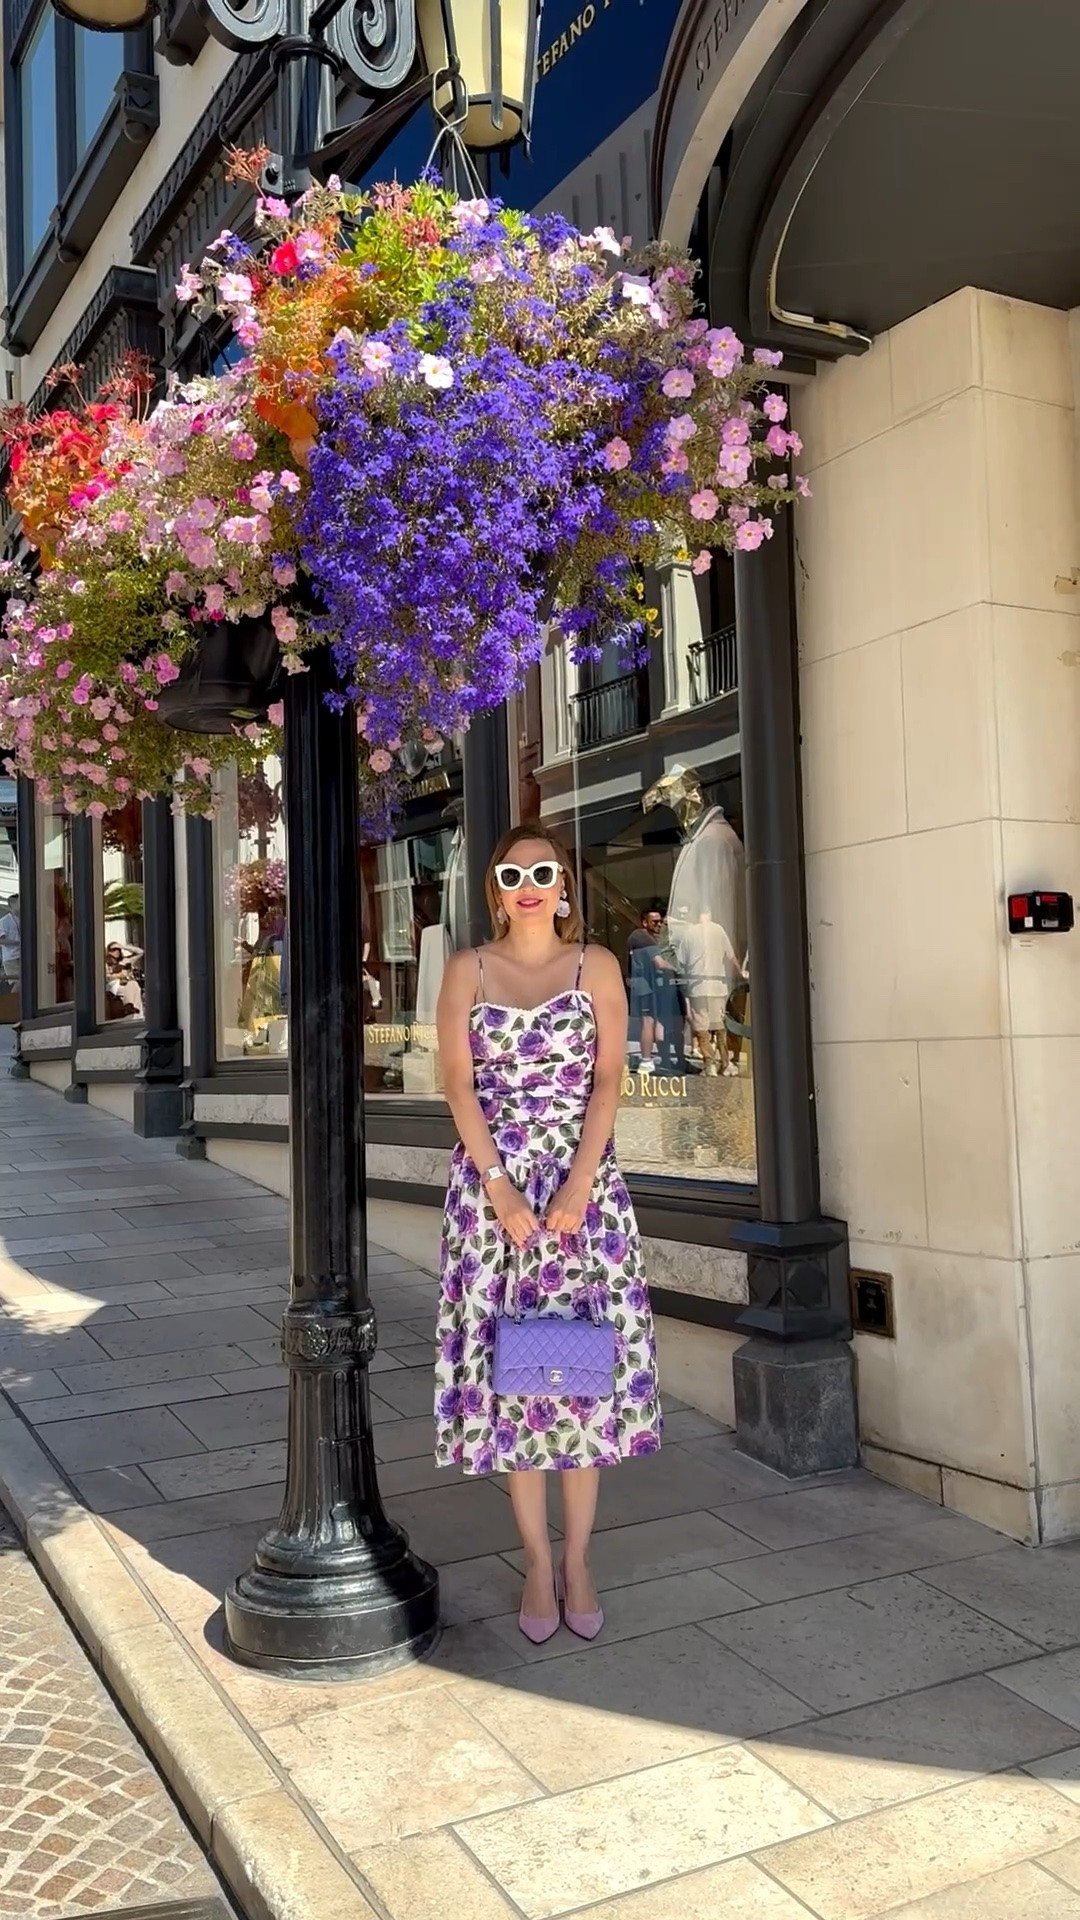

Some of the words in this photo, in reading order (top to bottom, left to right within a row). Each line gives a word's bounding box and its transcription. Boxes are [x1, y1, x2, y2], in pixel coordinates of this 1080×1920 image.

[534, 4, 595, 84] TEFANO
[368, 1025, 410, 1044] STEFANO
[412, 1021, 438, 1041] RICC
[640, 1072, 687, 1097] RICCI
